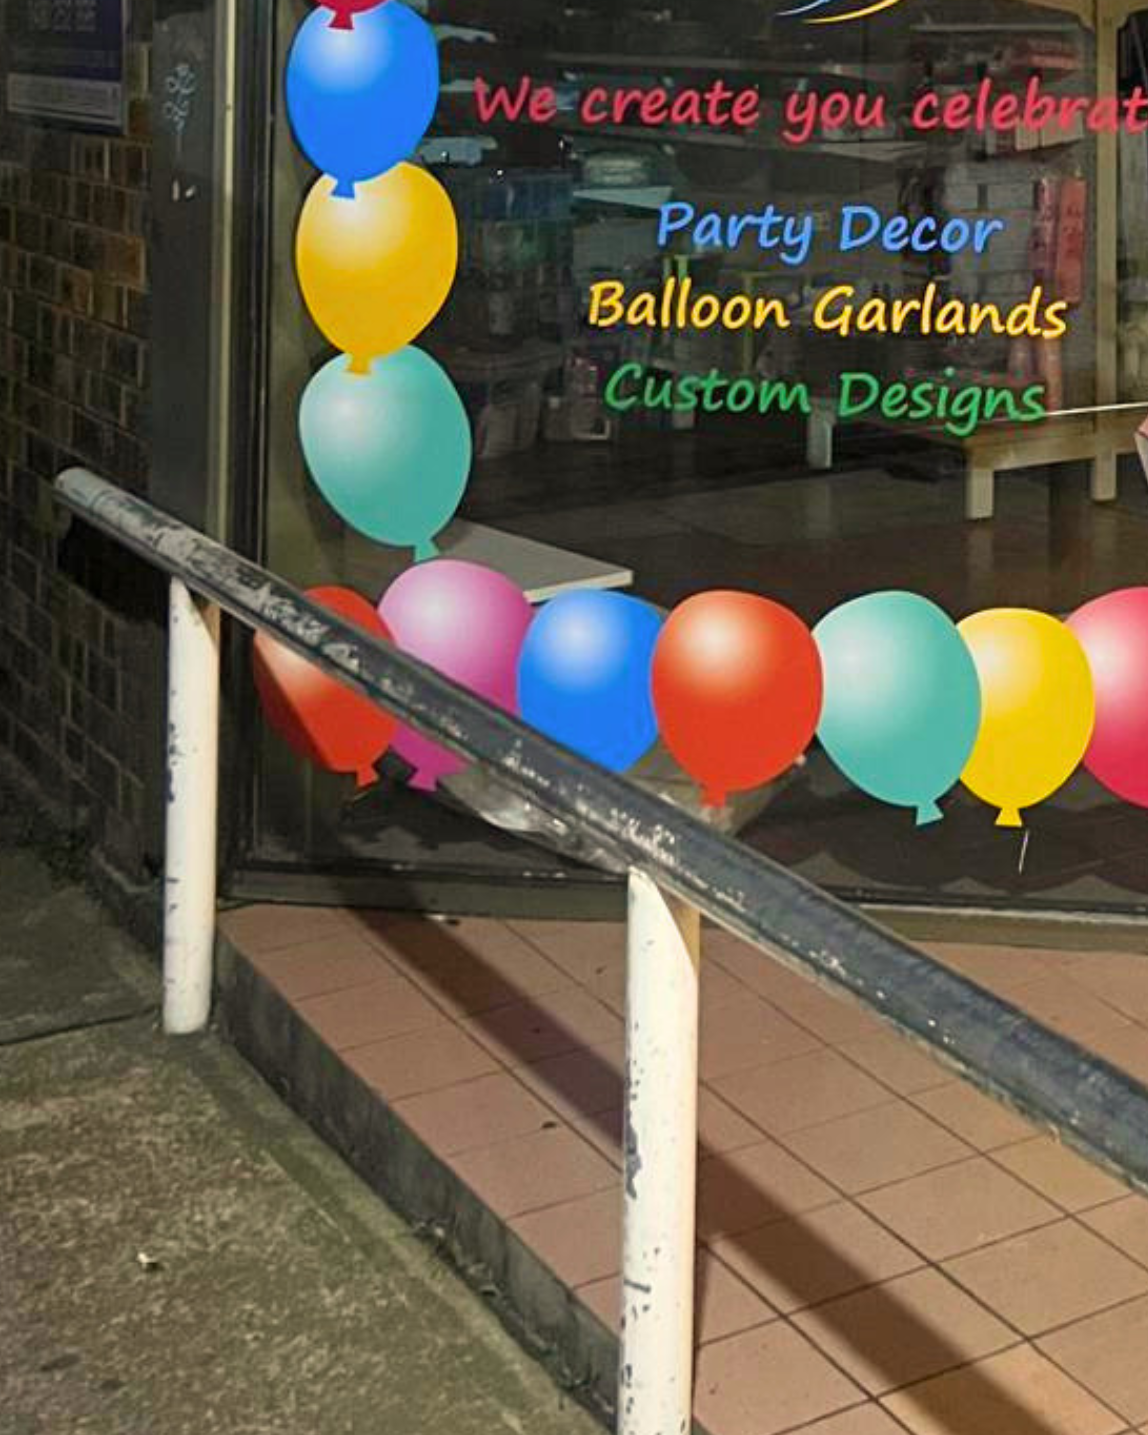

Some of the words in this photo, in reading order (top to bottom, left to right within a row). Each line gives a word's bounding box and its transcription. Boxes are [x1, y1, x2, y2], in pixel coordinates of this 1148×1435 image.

[473, 75, 557, 123] We
[581, 83, 760, 126] create
[784, 92, 886, 145] you
[657, 200, 815, 267] Party
[838, 204, 1003, 254] Decor
[588, 276, 790, 330] Balloon
[813, 283, 1068, 341] Garlands
[604, 360, 812, 415] Custom
[834, 370, 1047, 437] Designs
